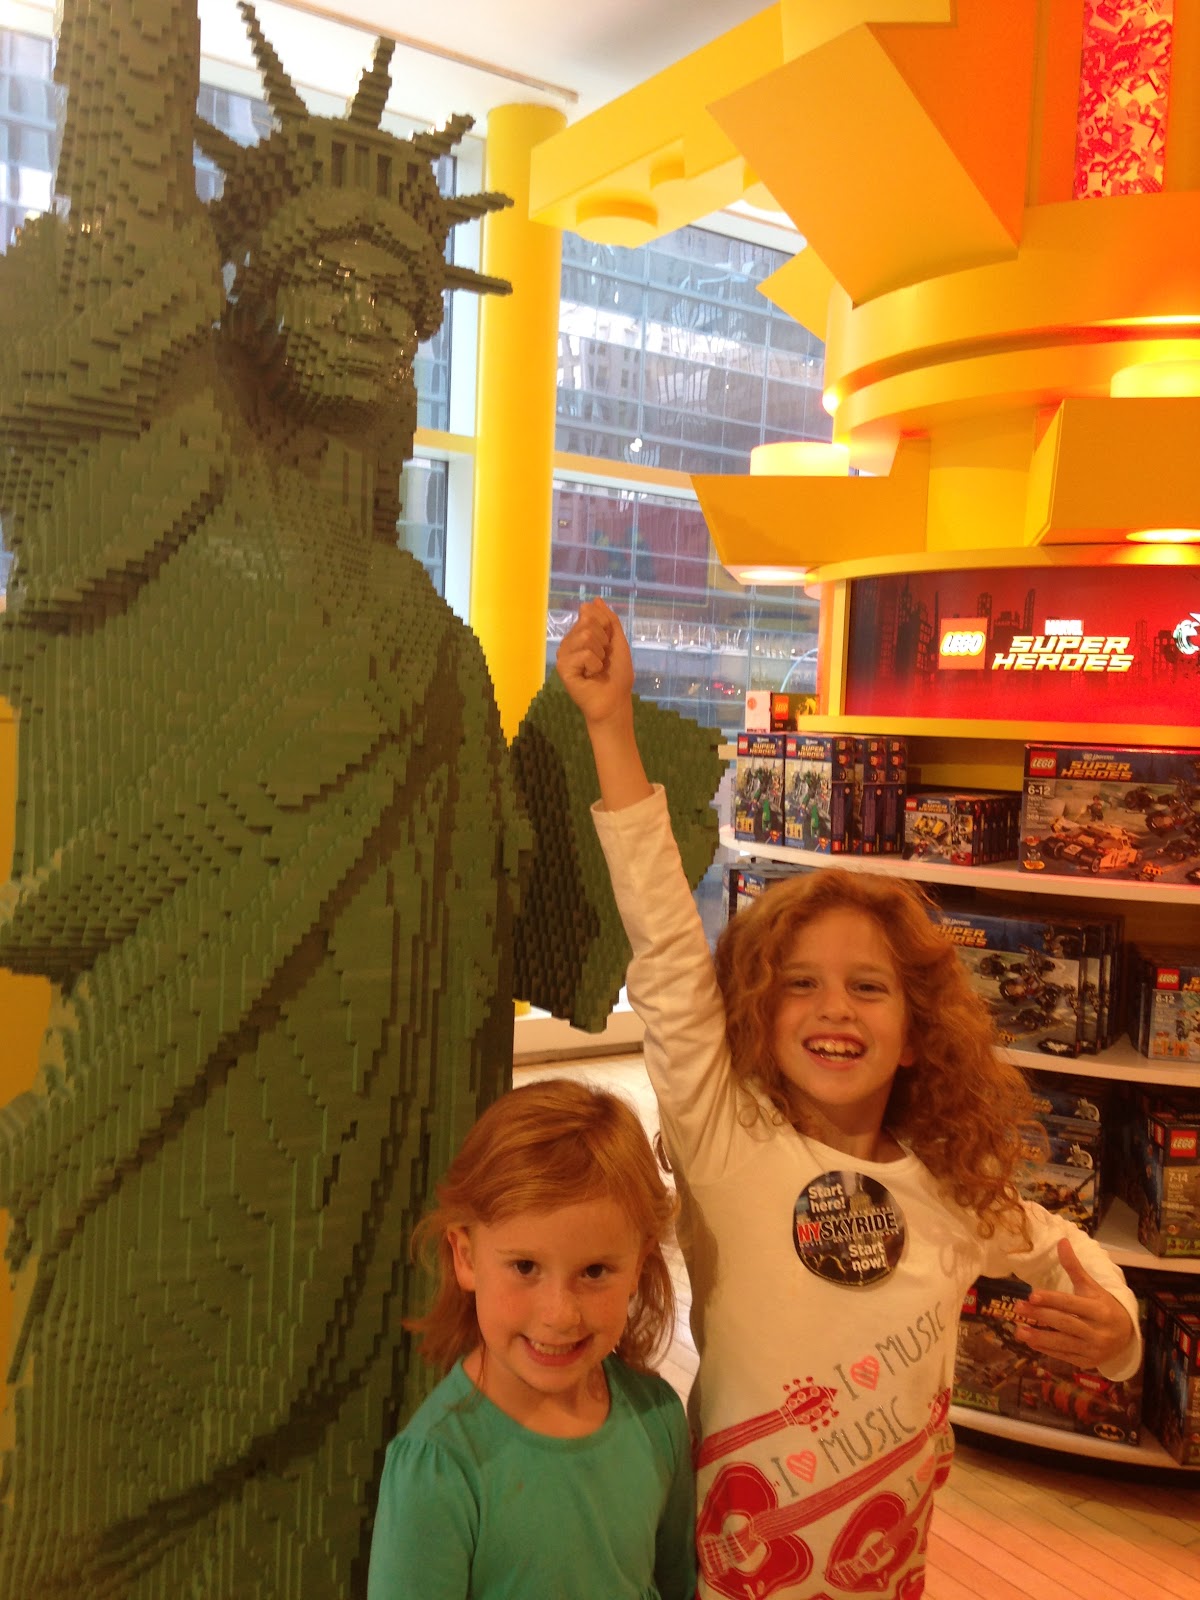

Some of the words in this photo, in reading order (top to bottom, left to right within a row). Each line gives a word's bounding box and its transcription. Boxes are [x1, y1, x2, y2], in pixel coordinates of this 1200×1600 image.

[941, 632, 985, 656] LEGO
[1009, 635, 1131, 654] SUPER
[991, 652, 1135, 672] HEROES
[752, 742, 776, 750] SUPER
[801, 744, 824, 752] SUPER
[1031, 757, 1056, 769] LEGO
[1070, 760, 1131, 770] SUPER
[1061, 768, 1133, 780] HEROES
[1028, 785, 1051, 796] 6-12
[1158, 974, 1179, 983] LEGO
[1171, 1137, 1196, 1150] LEGO
[808, 1183, 843, 1200] Start
[810, 1196, 846, 1213] here!
[851, 1255, 887, 1272] now!
[833, 1363, 859, 1400] I
[875, 1301, 945, 1376] MUSIC
[770, 1456, 799, 1497] I
[818, 1396, 917, 1474] MUSIC
